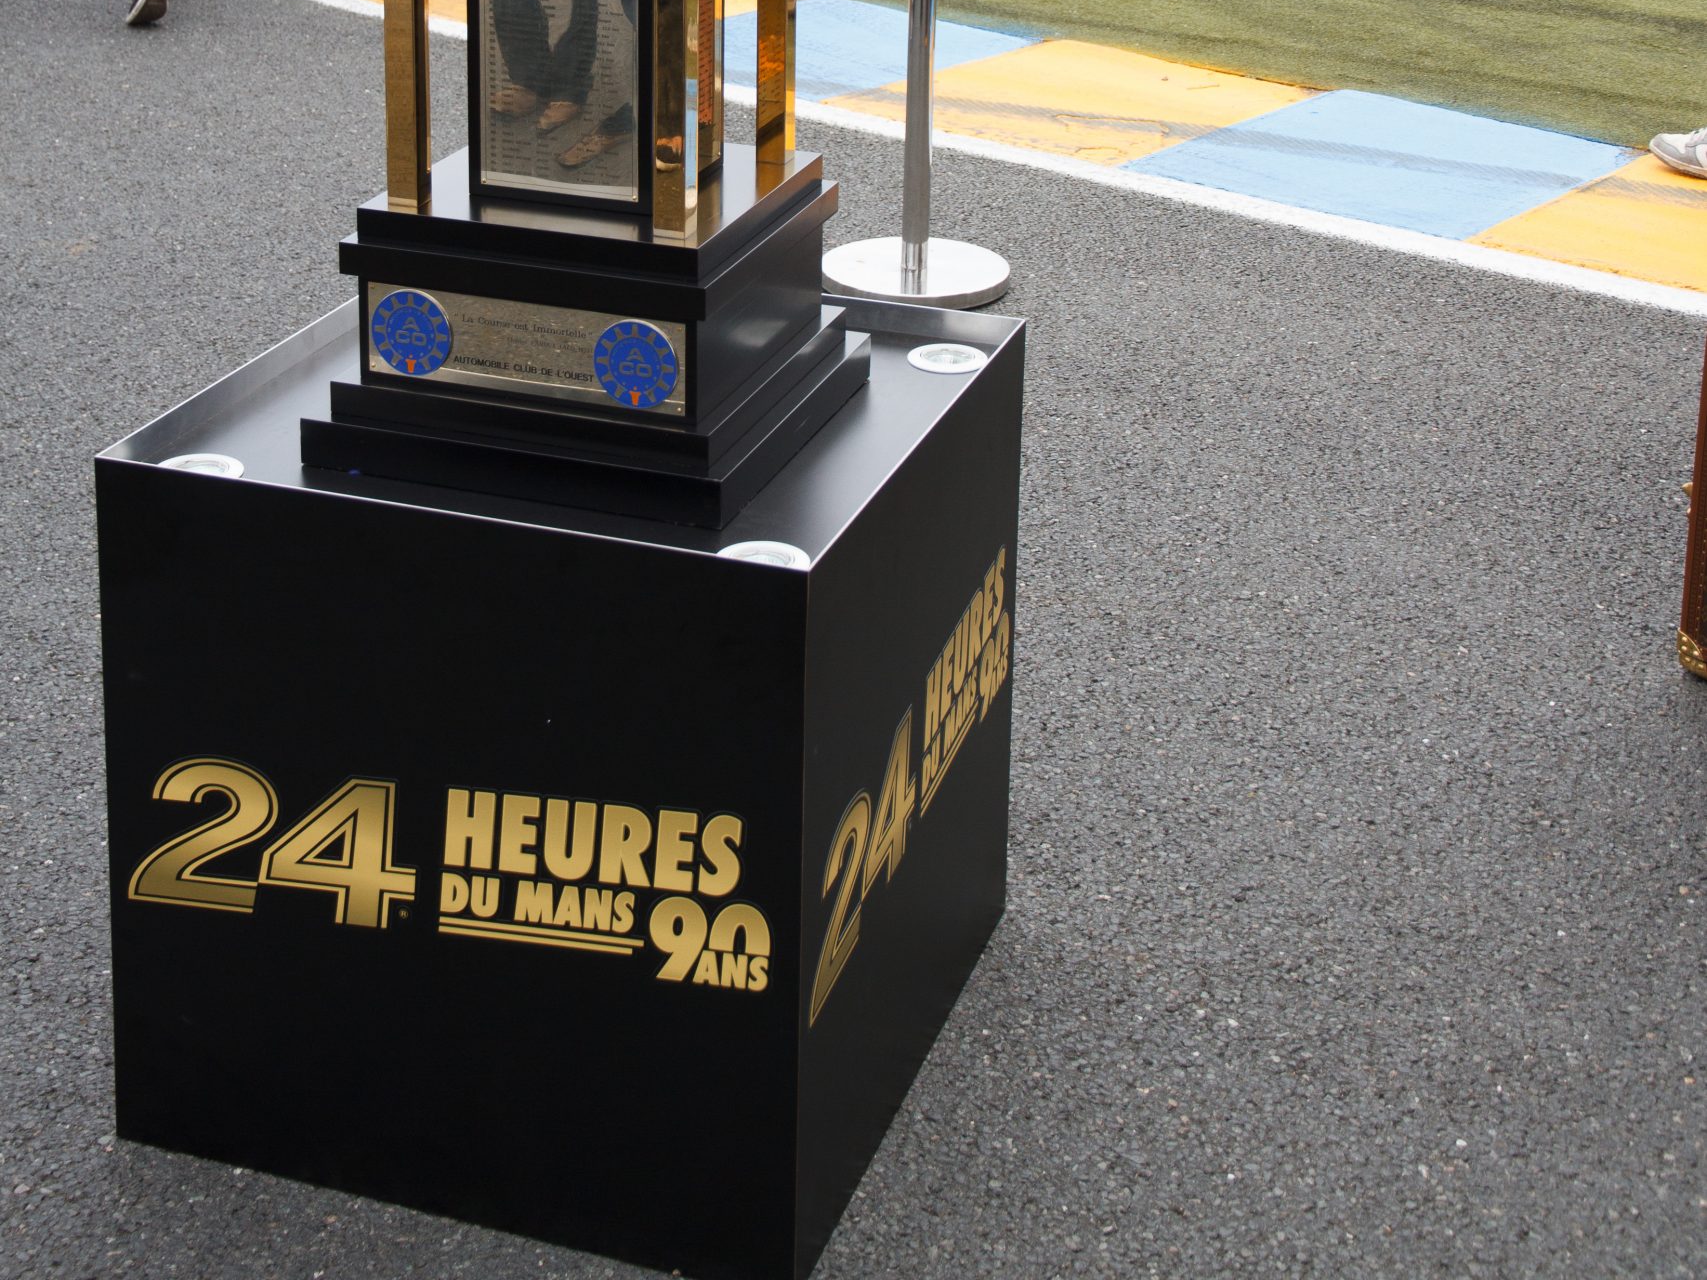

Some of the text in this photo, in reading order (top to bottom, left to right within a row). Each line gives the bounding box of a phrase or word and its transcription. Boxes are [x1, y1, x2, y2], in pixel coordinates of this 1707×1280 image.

[454, 355, 594, 382] AUTOMOBILE CLUB DE L'OUEST
[924, 544, 1006, 753] HEURES
[921, 665, 978, 803] DU MANS
[127, 756, 417, 930] 24
[440, 871, 635, 934] DU MANS
[443, 788, 743, 898] HEURES
[809, 704, 917, 1028] 24
[692, 949, 769, 992] ANS
